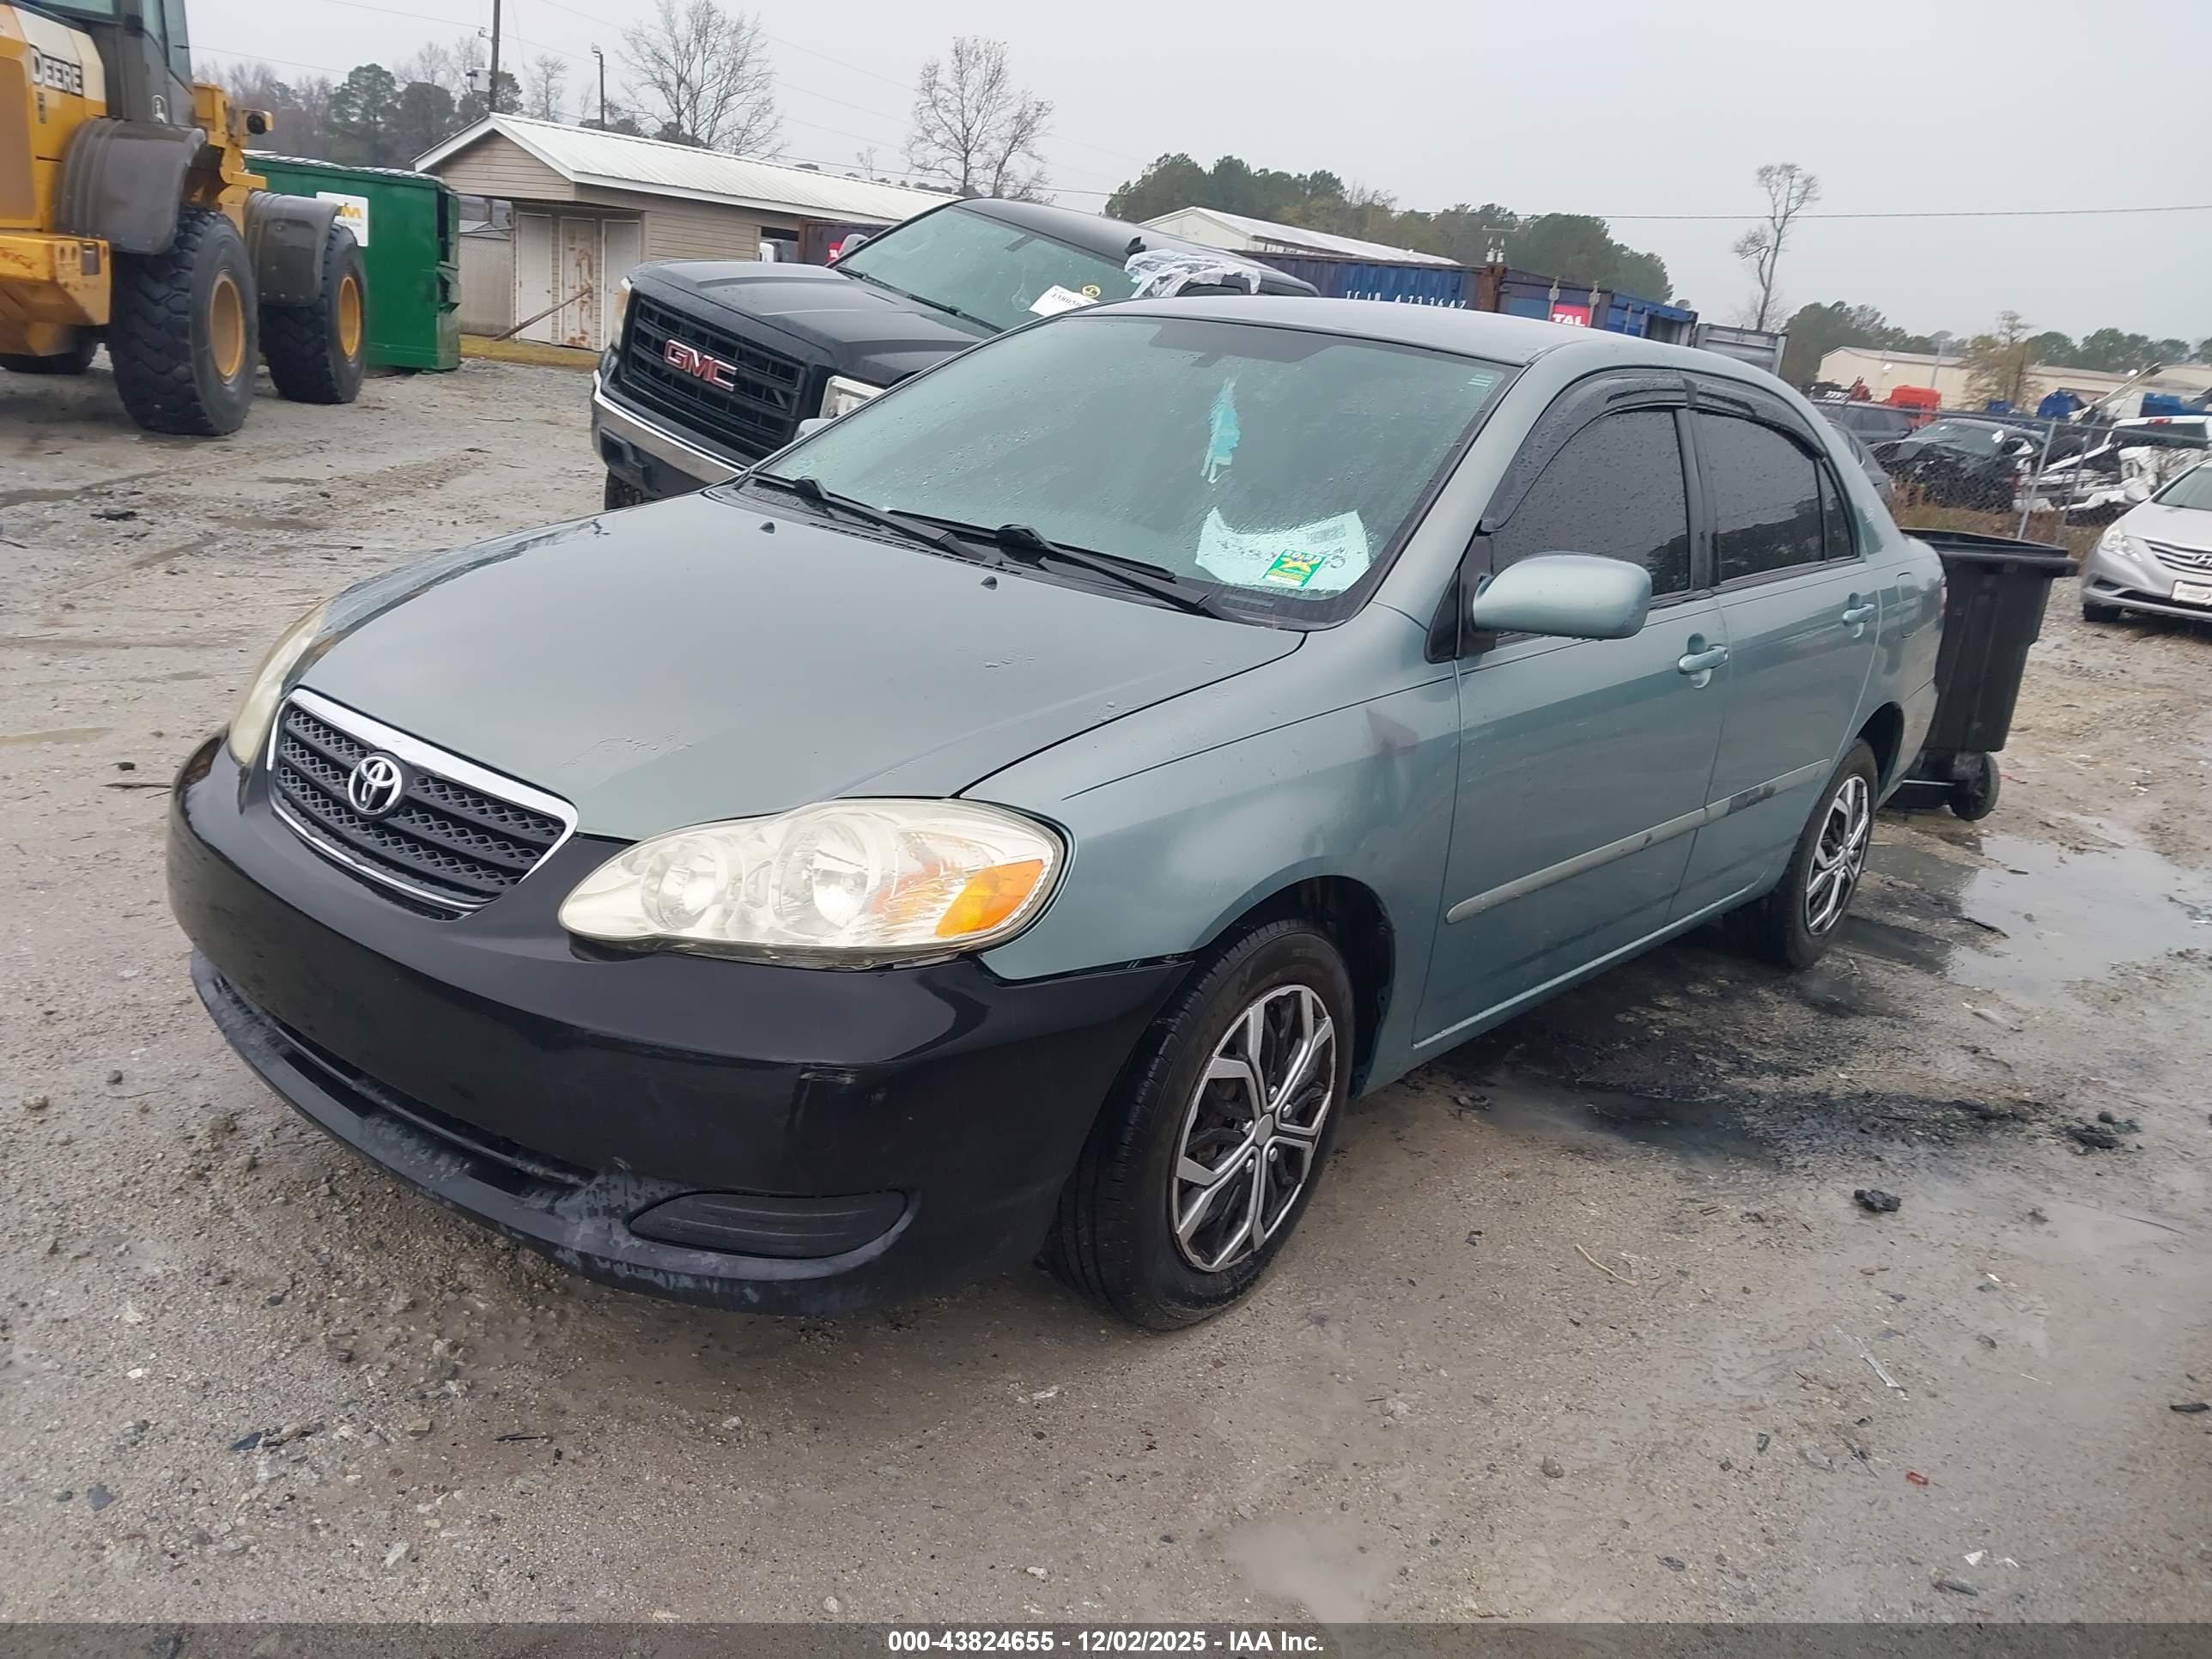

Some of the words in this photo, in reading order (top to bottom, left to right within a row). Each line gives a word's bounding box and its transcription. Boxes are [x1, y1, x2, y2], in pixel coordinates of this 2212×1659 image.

[29, 43, 83, 97] DEERE
[1553, 313, 1586, 326] TAL
[664, 339, 738, 392] GMC
